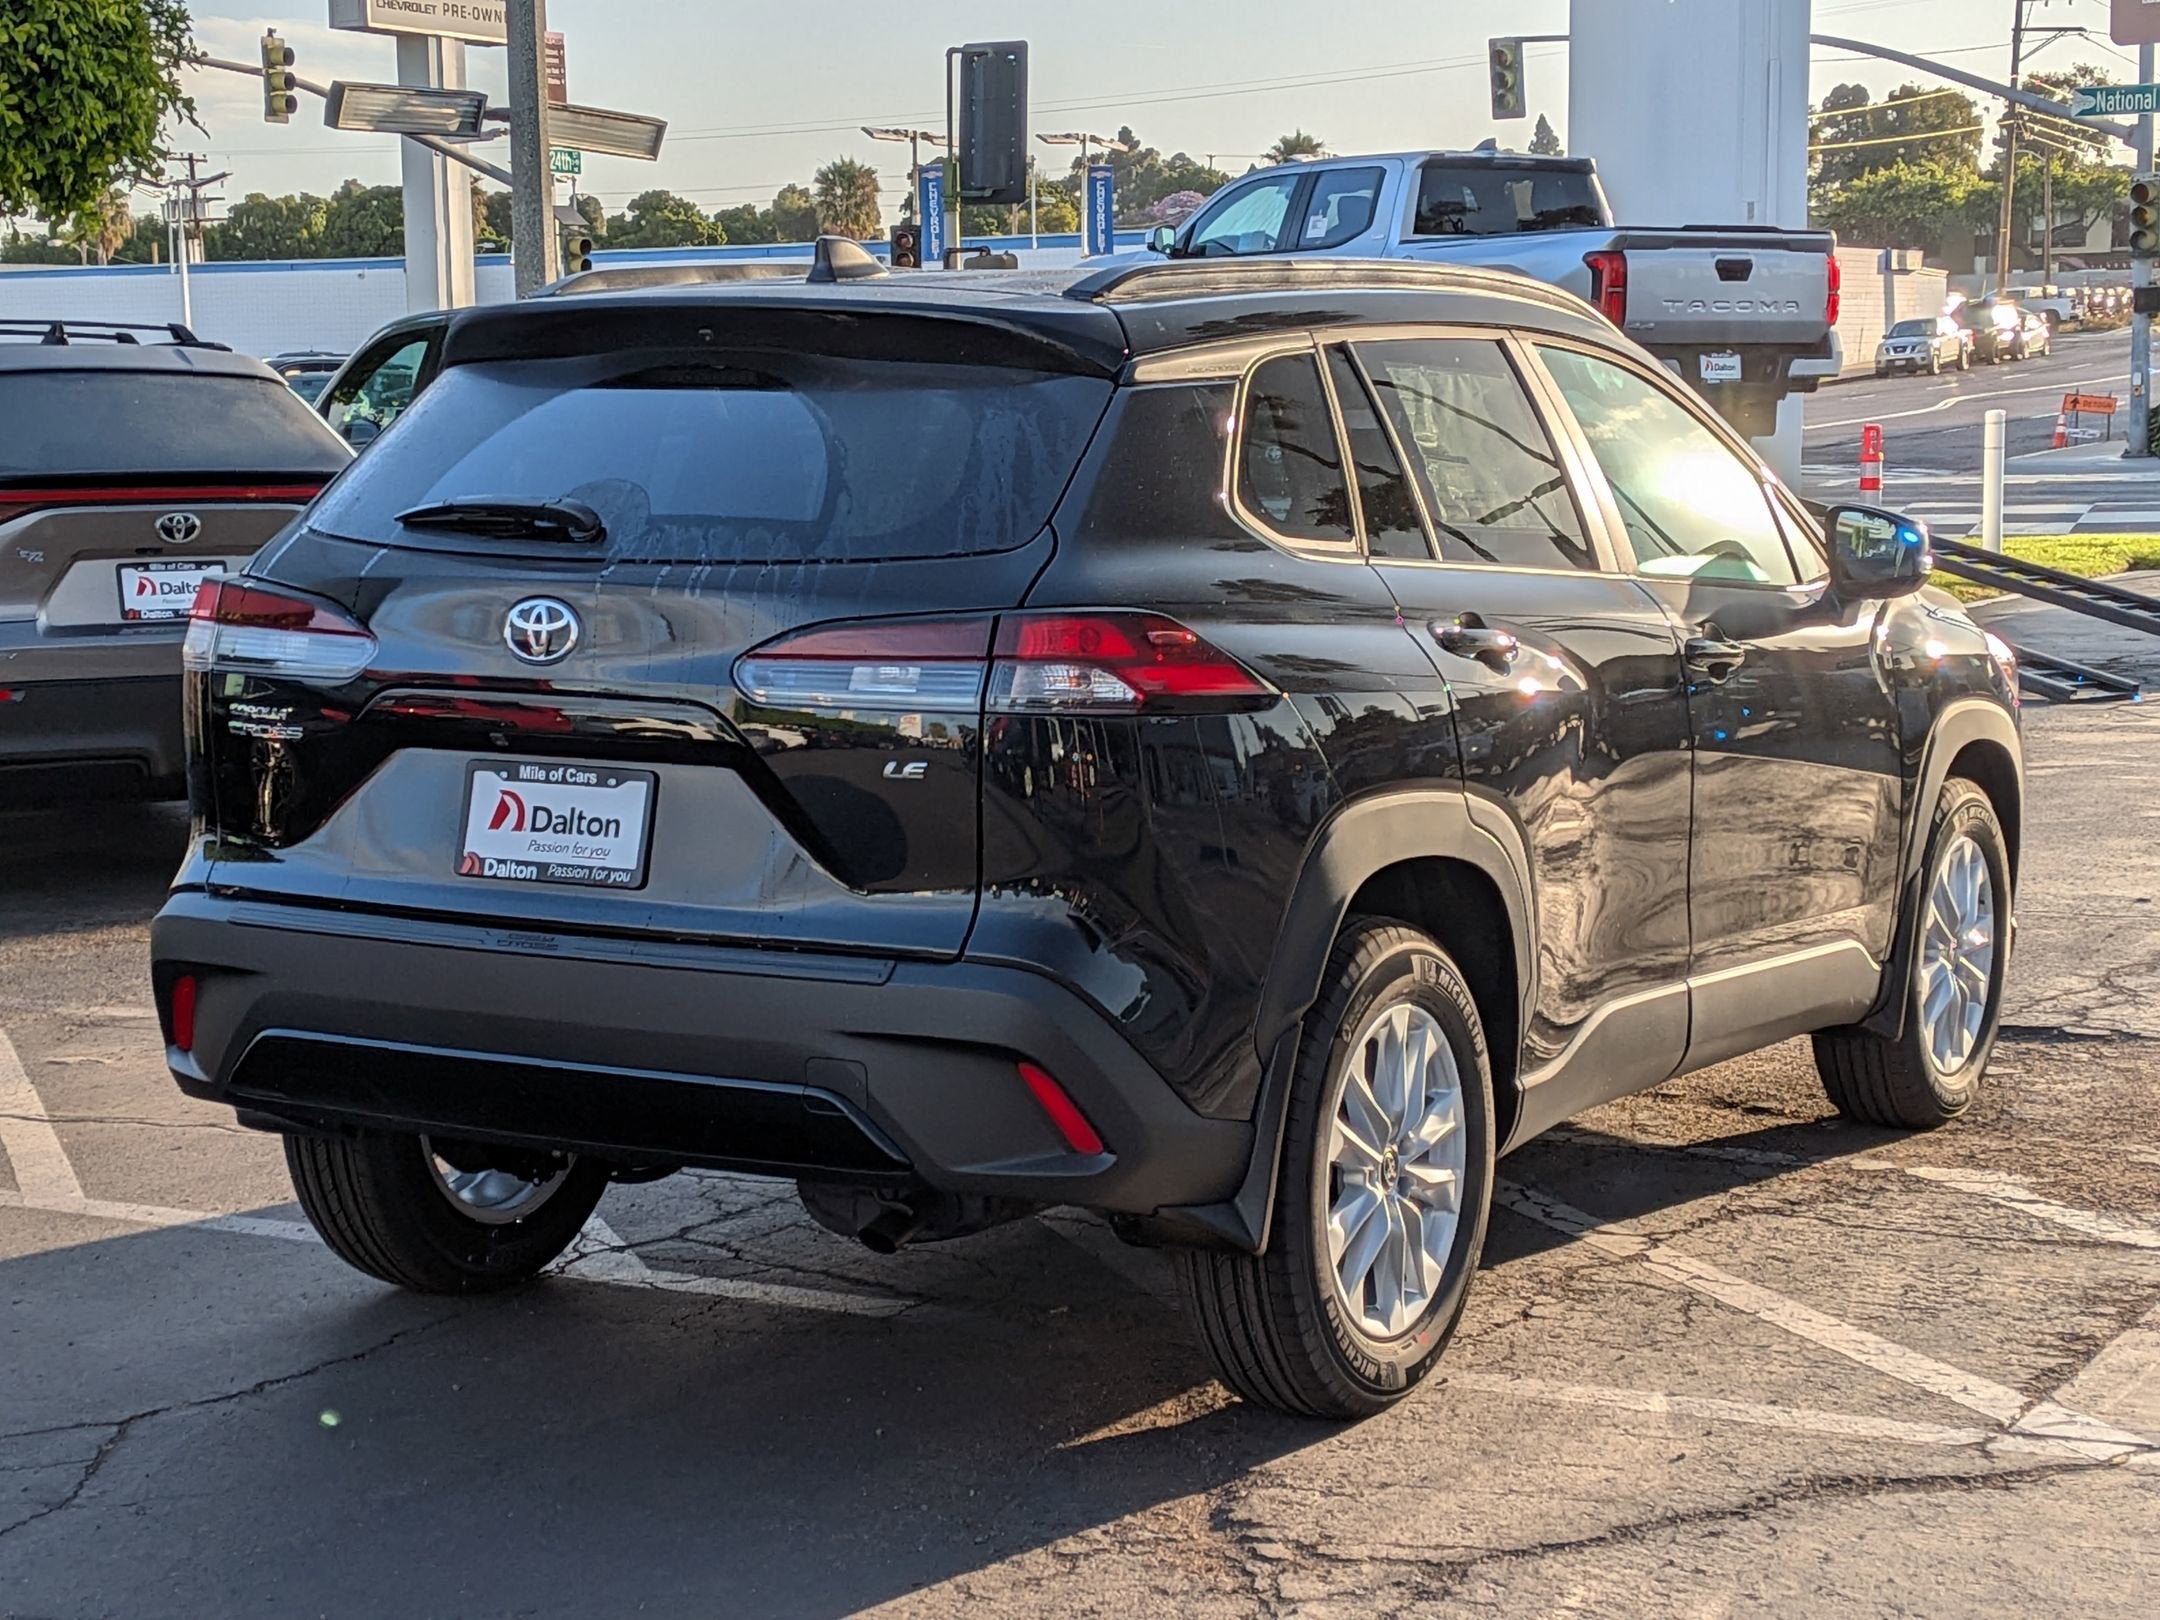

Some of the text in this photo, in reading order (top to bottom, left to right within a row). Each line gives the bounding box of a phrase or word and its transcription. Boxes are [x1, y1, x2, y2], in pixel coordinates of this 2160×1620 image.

[376, 0, 506, 23] CHEVROLET PRE-OWN
[2096, 87, 2157, 113] National
[549, 151, 572, 171] 24th
[928, 181, 940, 260] CHEVROLET
[1096, 180, 1106, 254] CHEVROLET
[1662, 299, 1800, 314] TACOMA
[1714, 362, 1737, 372] Dalton
[160, 581, 200, 596] Dalto
[228, 721, 303, 739] CROSS
[519, 764, 598, 785] Mile of Cars
[883, 761, 928, 779] LE
[529, 805, 621, 839] Dalton
[527, 839, 611, 858] Passion for you
[483, 858, 632, 884] Dalton Passion for you
[1437, 967, 1485, 1055] MICHELIN
[1325, 1299, 1380, 1381] MICHELIN
